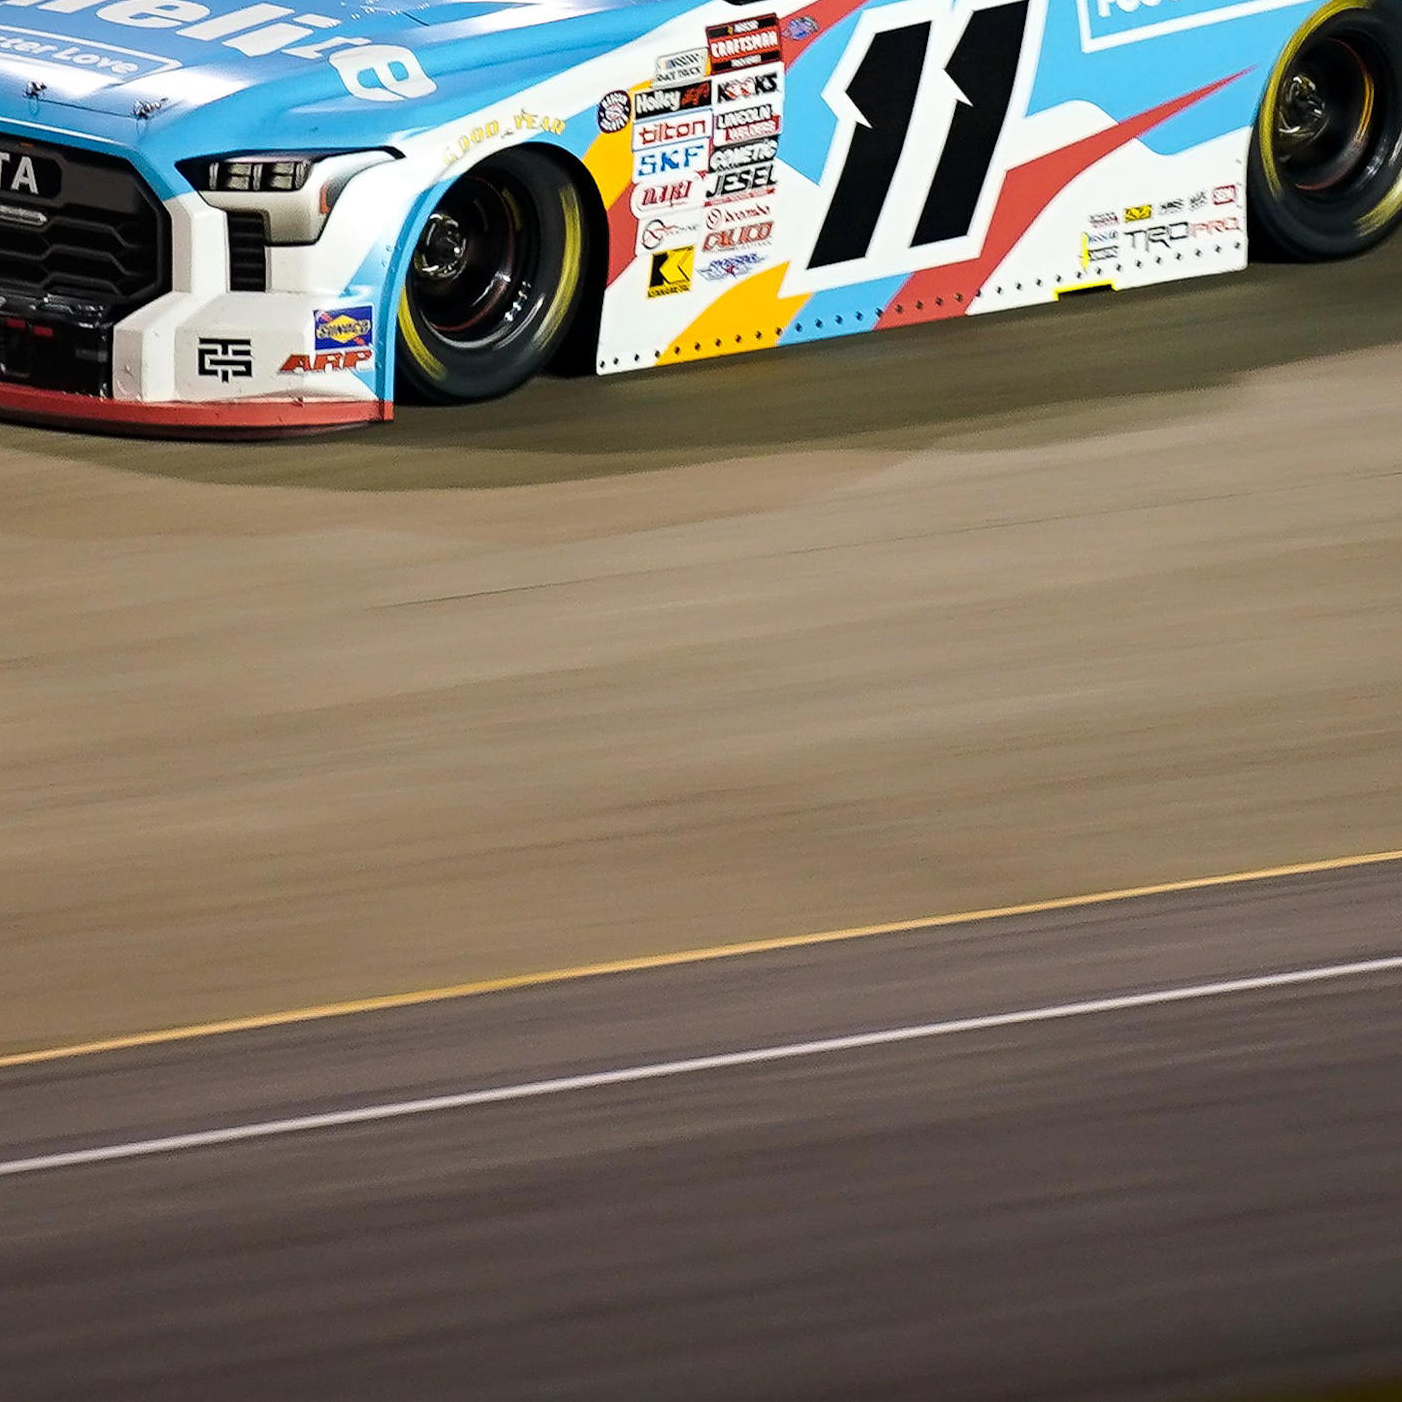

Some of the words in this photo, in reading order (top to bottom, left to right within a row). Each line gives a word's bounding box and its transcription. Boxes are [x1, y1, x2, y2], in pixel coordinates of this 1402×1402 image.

[639, 119, 706, 146] tilton
[638, 144, 704, 177] SKF
[706, 163, 778, 198] JESEL
[278, 349, 372, 373] ARP
